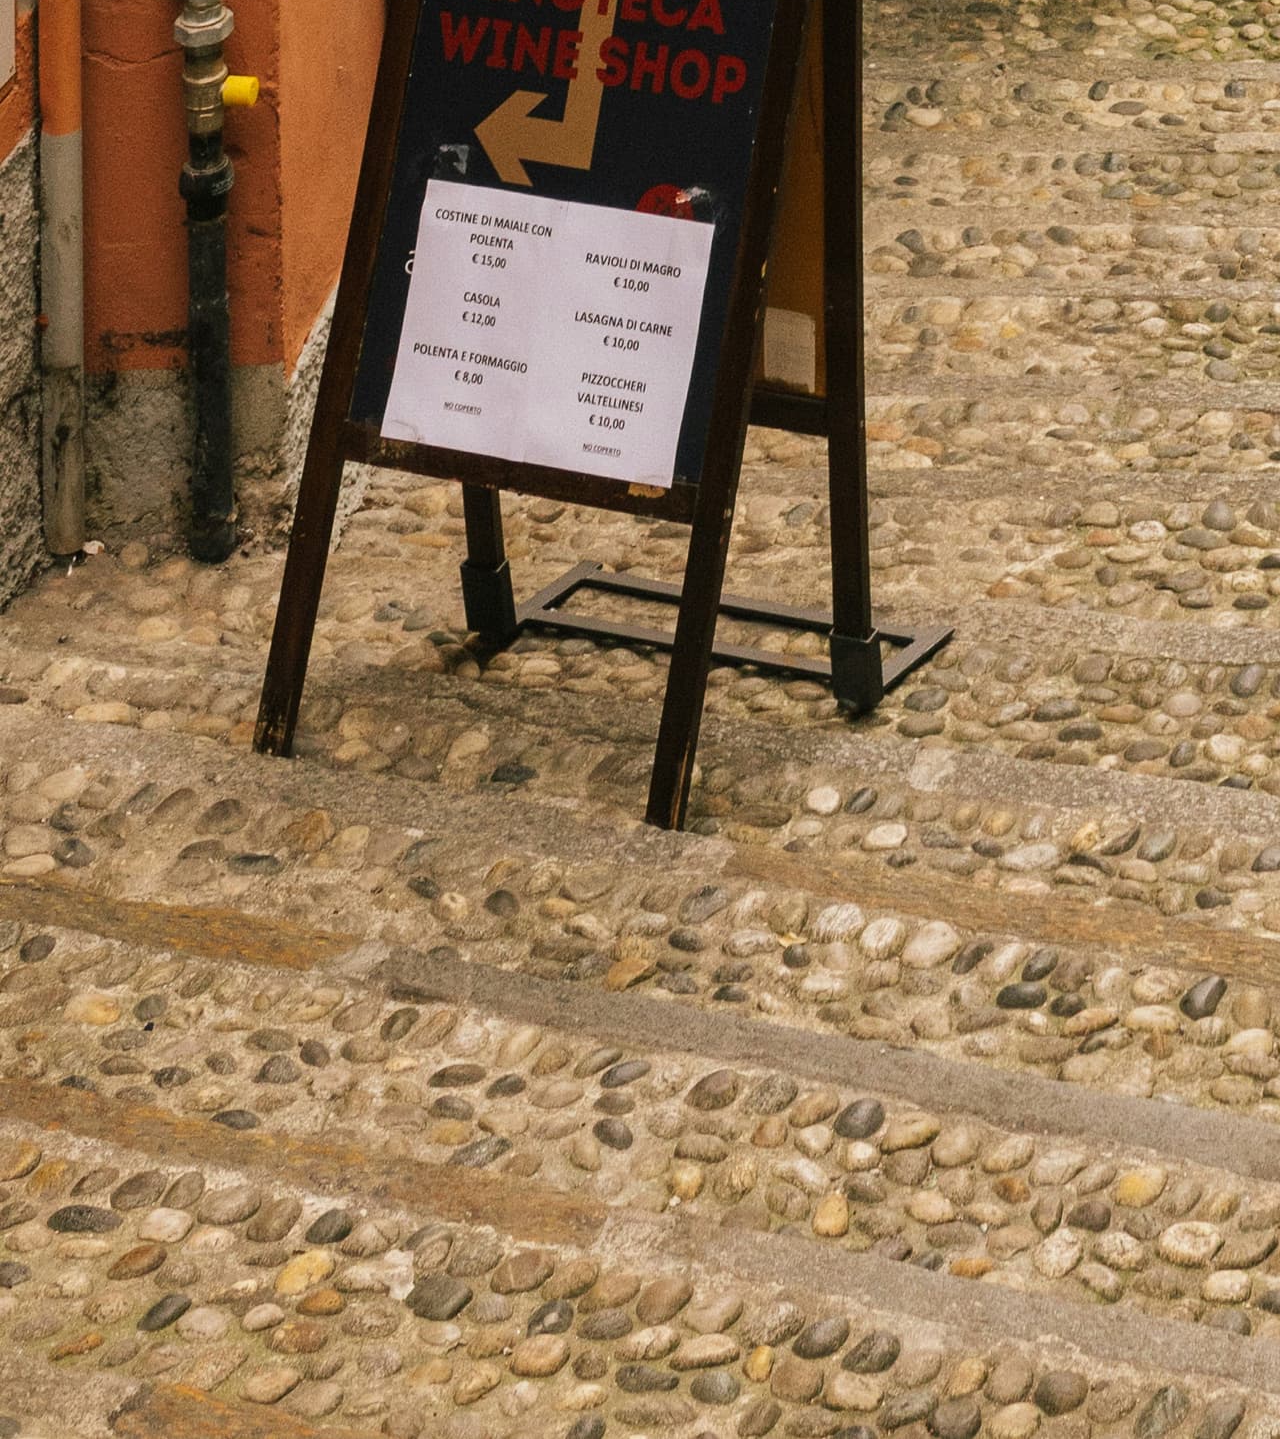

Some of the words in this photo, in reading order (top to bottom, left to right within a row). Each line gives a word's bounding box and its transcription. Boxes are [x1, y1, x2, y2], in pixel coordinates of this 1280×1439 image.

[439, 10, 584, 81] WINE
[595, 35, 748, 104] SHOP
[435, 208, 478, 225] COSTINE
[481, 216, 492, 227] DI
[494, 217, 529, 234] MAIALE
[531, 224, 552, 238] CON
[469, 234, 514, 251] POLENTA
[481, 255, 507, 269] 15,00
[585, 252, 628, 269] RAVIOLI
[629, 259, 640, 271] DI
[642, 261, 681, 278] MAGRO
[623, 278, 650, 293] 10,00
[463, 291, 501, 307] CASOLA
[471, 313, 496, 327] 12,00
[574, 311, 623, 329] LASAGNA
[626, 319, 637, 330] DI
[639, 321, 673, 337] CARNE
[612, 336, 640, 351] 10,00
[413, 342, 458, 361] POLENTA
[469, 352, 528, 374] FORMAGGIO
[462, 371, 483, 385] 8,00
[581, 372, 647, 393] PIZZOCCHERI
[444, 401, 453, 410] NO
[454, 402, 482, 415] COPERTO
[577, 392, 644, 413] VALTELLINESI
[598, 415, 625, 430] 10,00
[582, 443, 592, 451] NO
[593, 443, 621, 456] COPERTO
